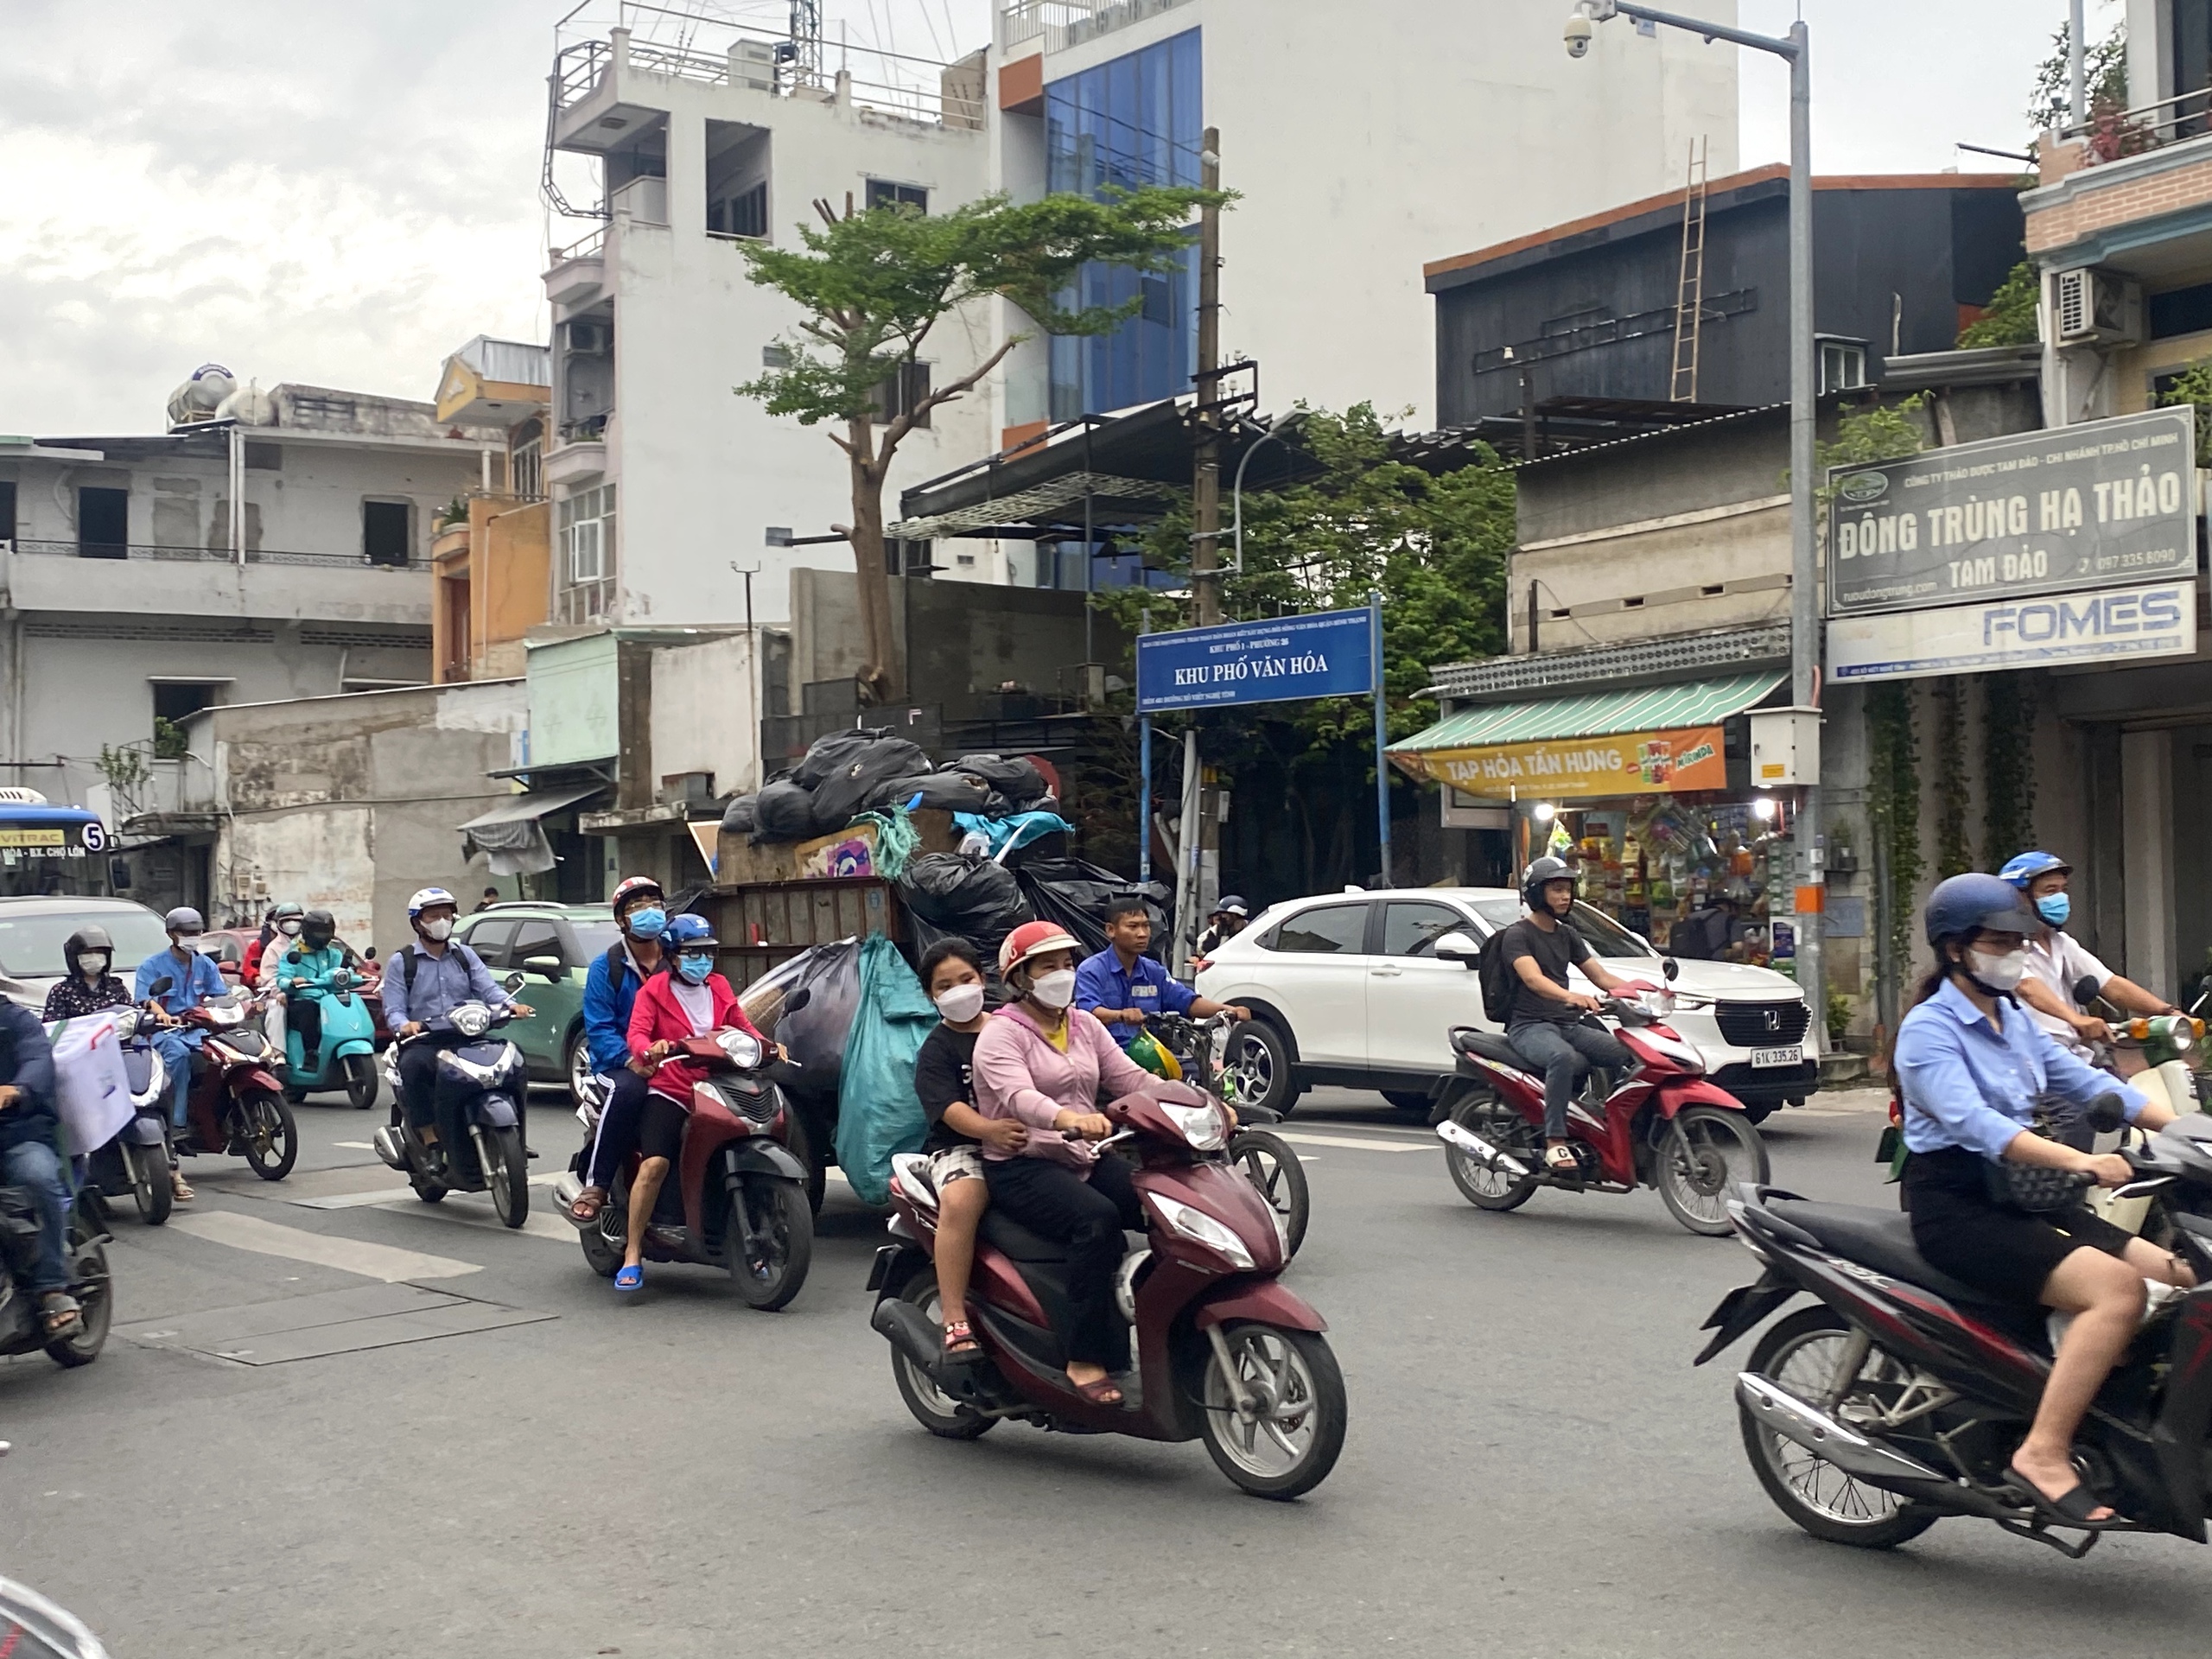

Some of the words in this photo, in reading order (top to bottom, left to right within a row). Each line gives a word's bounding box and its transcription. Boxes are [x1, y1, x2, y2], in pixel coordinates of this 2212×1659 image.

[1997, 459, 2018, 473] TAM
[2046, 452, 2063, 465] CHI
[2064, 445, 2101, 461] NHÁNH
[2131, 435, 2149, 450] CHÍ
[2150, 432, 2179, 447] MINH
[1839, 511, 1918, 560] ĐÔNG
[1928, 494, 2029, 547] TRÙNG
[2039, 486, 2083, 537] HẠ
[2093, 463, 2182, 524] THẢO
[1948, 558, 1995, 589] TAM
[2003, 543, 2049, 583] ĐẢO
[1983, 590, 2182, 646] FOMES
[1174, 666, 1210, 685] KHU
[1213, 654, 1249, 682] PHỐ
[1251, 655, 1287, 678] VĂN
[1289, 650, 1329, 675] HÓA
[1446, 760, 1480, 786] TẠP
[1481, 752, 1525, 779] HÓA
[1564, 748, 1624, 774] HƯNG
[46, 846, 67, 861] CHỢ
[87, 826, 101, 849] 5
